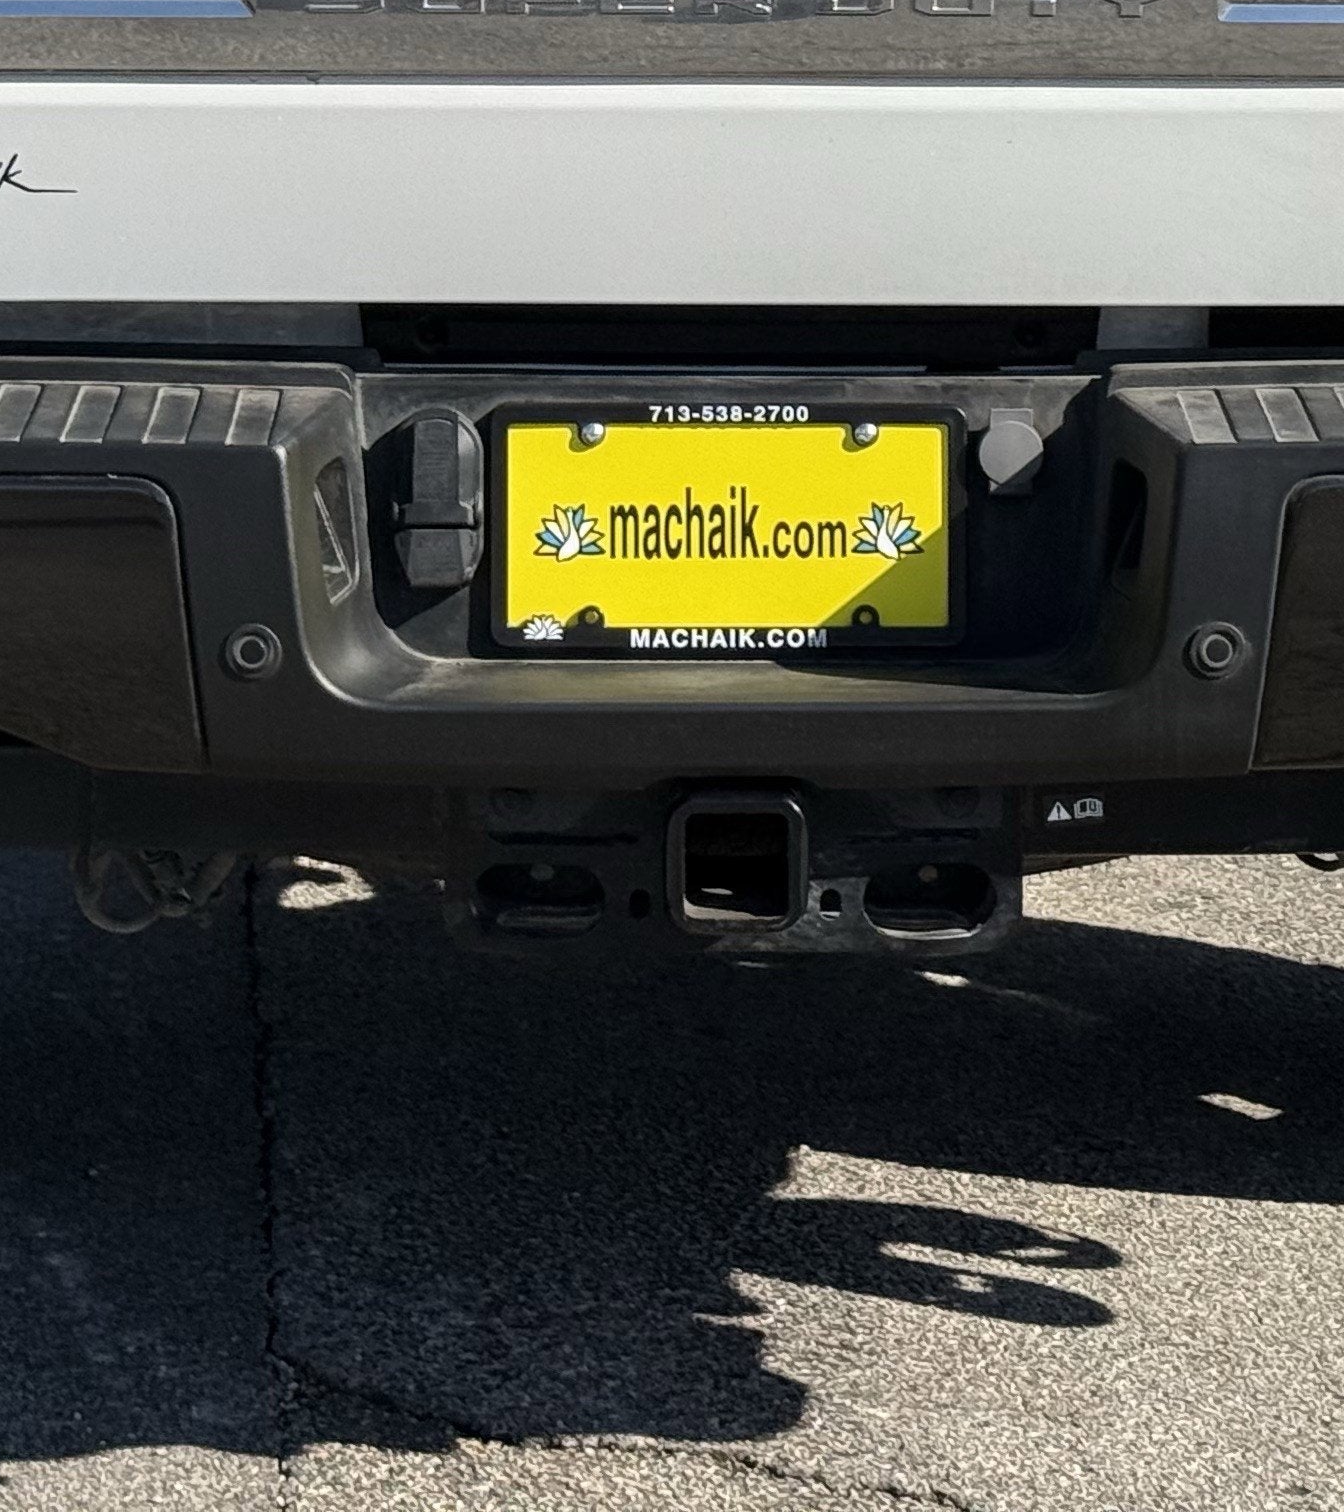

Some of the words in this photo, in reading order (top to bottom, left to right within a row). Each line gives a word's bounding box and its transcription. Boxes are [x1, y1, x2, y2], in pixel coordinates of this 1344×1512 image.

[648, 405, 810, 422] 713-538-2700
[609, 486, 847, 560] machaik.com
[630, 627, 828, 649] MACHAIK.COM
